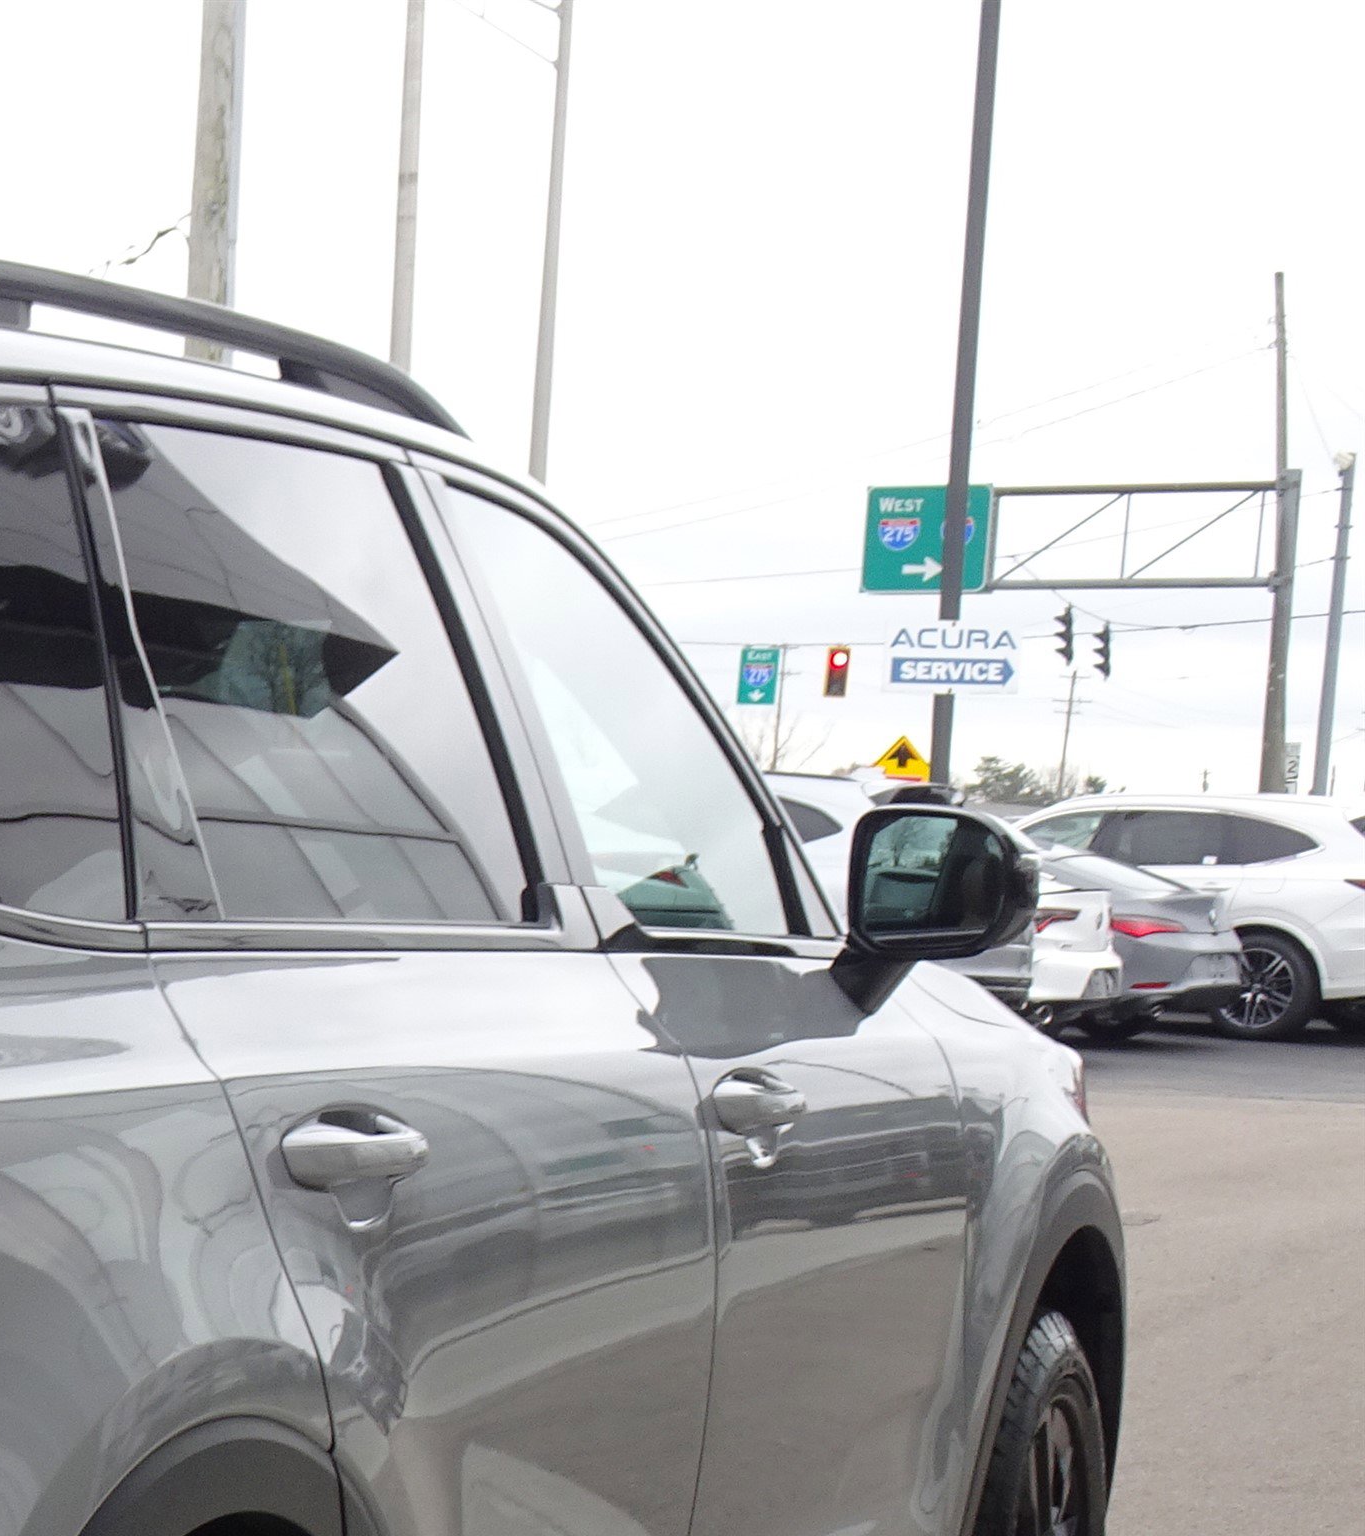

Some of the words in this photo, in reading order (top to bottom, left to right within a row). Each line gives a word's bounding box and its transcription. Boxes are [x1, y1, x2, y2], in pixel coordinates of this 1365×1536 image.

[878, 497, 925, 514] WEST
[882, 526, 915, 542] 275
[890, 628, 1017, 650] ACURA
[899, 660, 1005, 682] SERVICE
